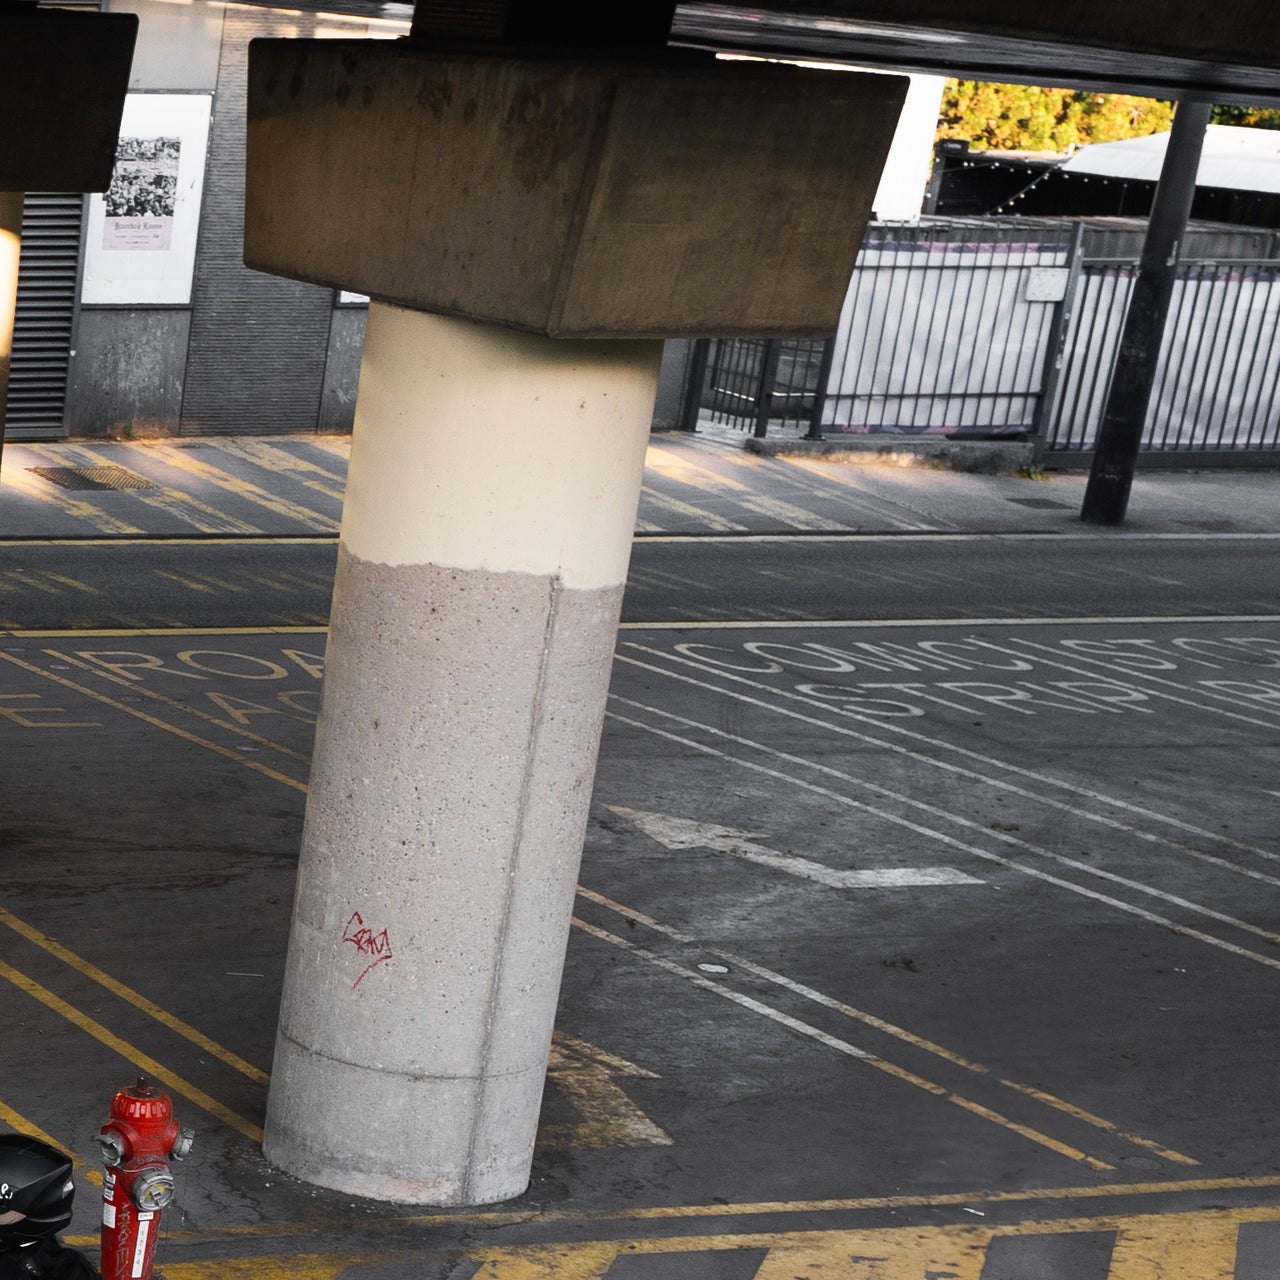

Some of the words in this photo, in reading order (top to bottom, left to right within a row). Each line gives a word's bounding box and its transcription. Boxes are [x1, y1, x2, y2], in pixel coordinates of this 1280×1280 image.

[673, 640, 1034, 674] COMIC
[1059, 637, 1280, 670] STO
[794, 682, 1155, 718] STRIP
